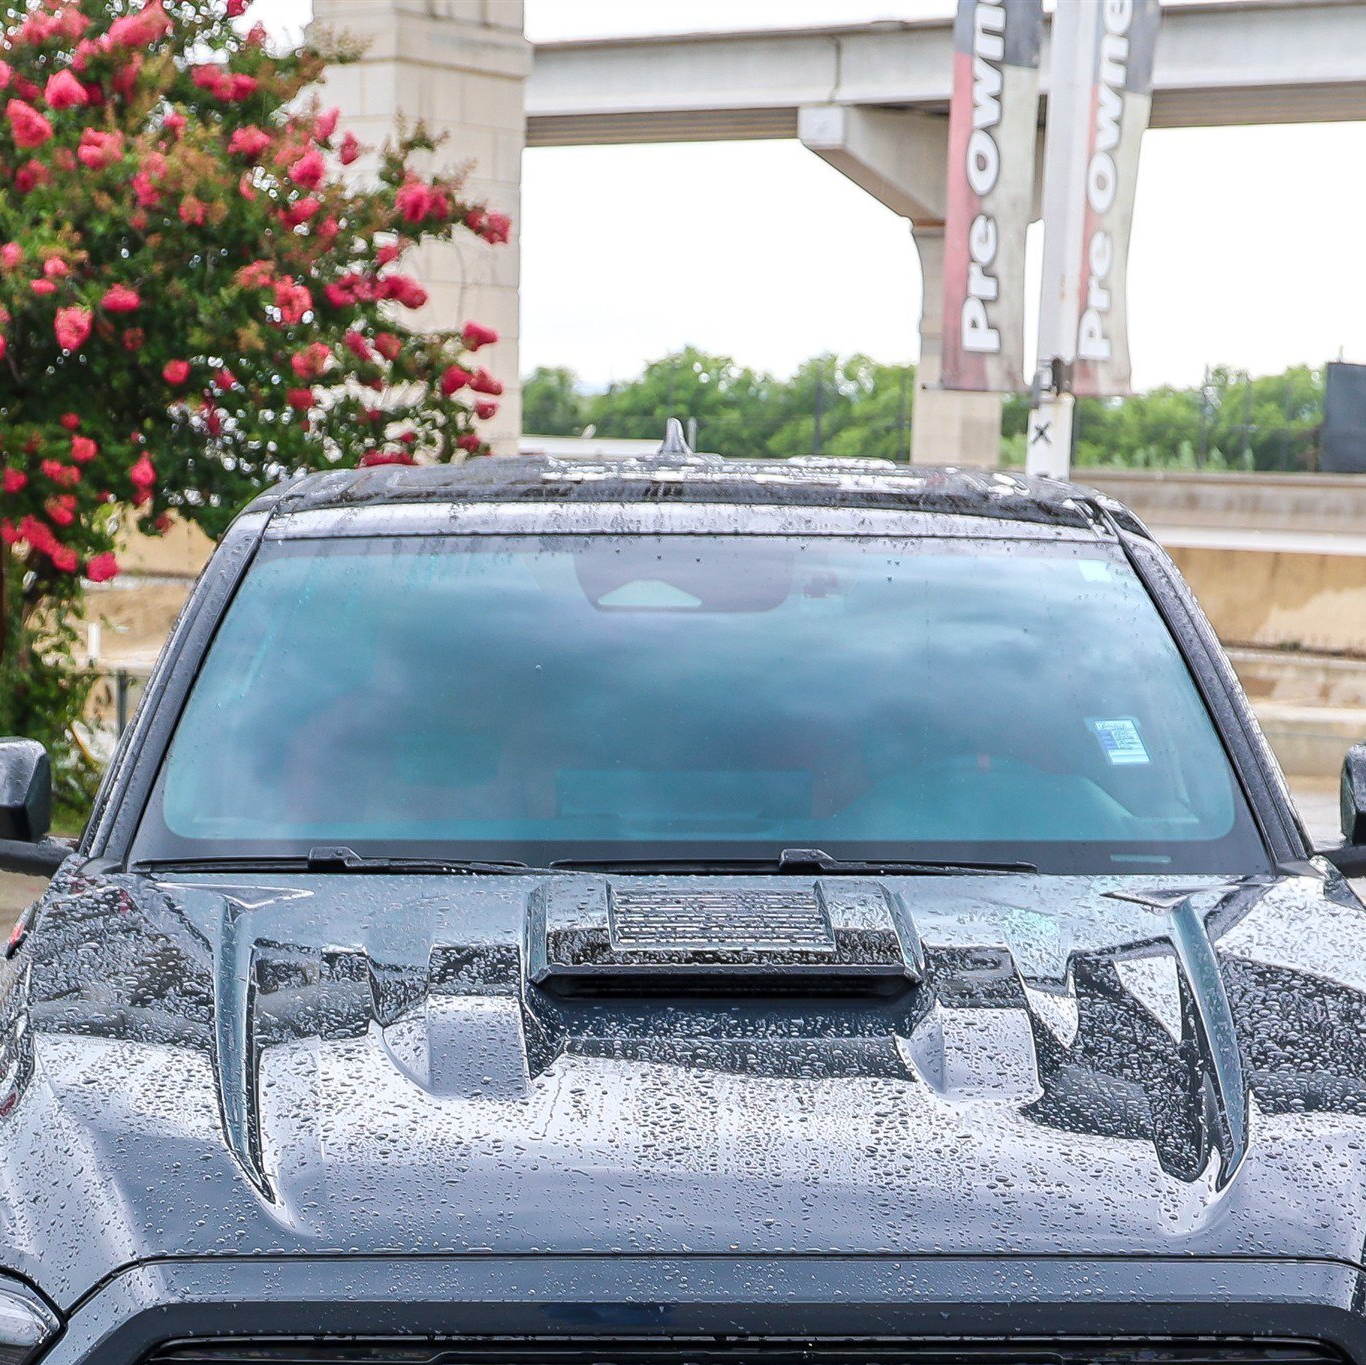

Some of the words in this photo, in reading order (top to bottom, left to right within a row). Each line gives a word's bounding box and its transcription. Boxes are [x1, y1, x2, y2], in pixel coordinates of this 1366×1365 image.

[966, 0, 1007, 197] Own
[961, 213, 1002, 354] Pre
[1077, 230, 1113, 361] Pre
